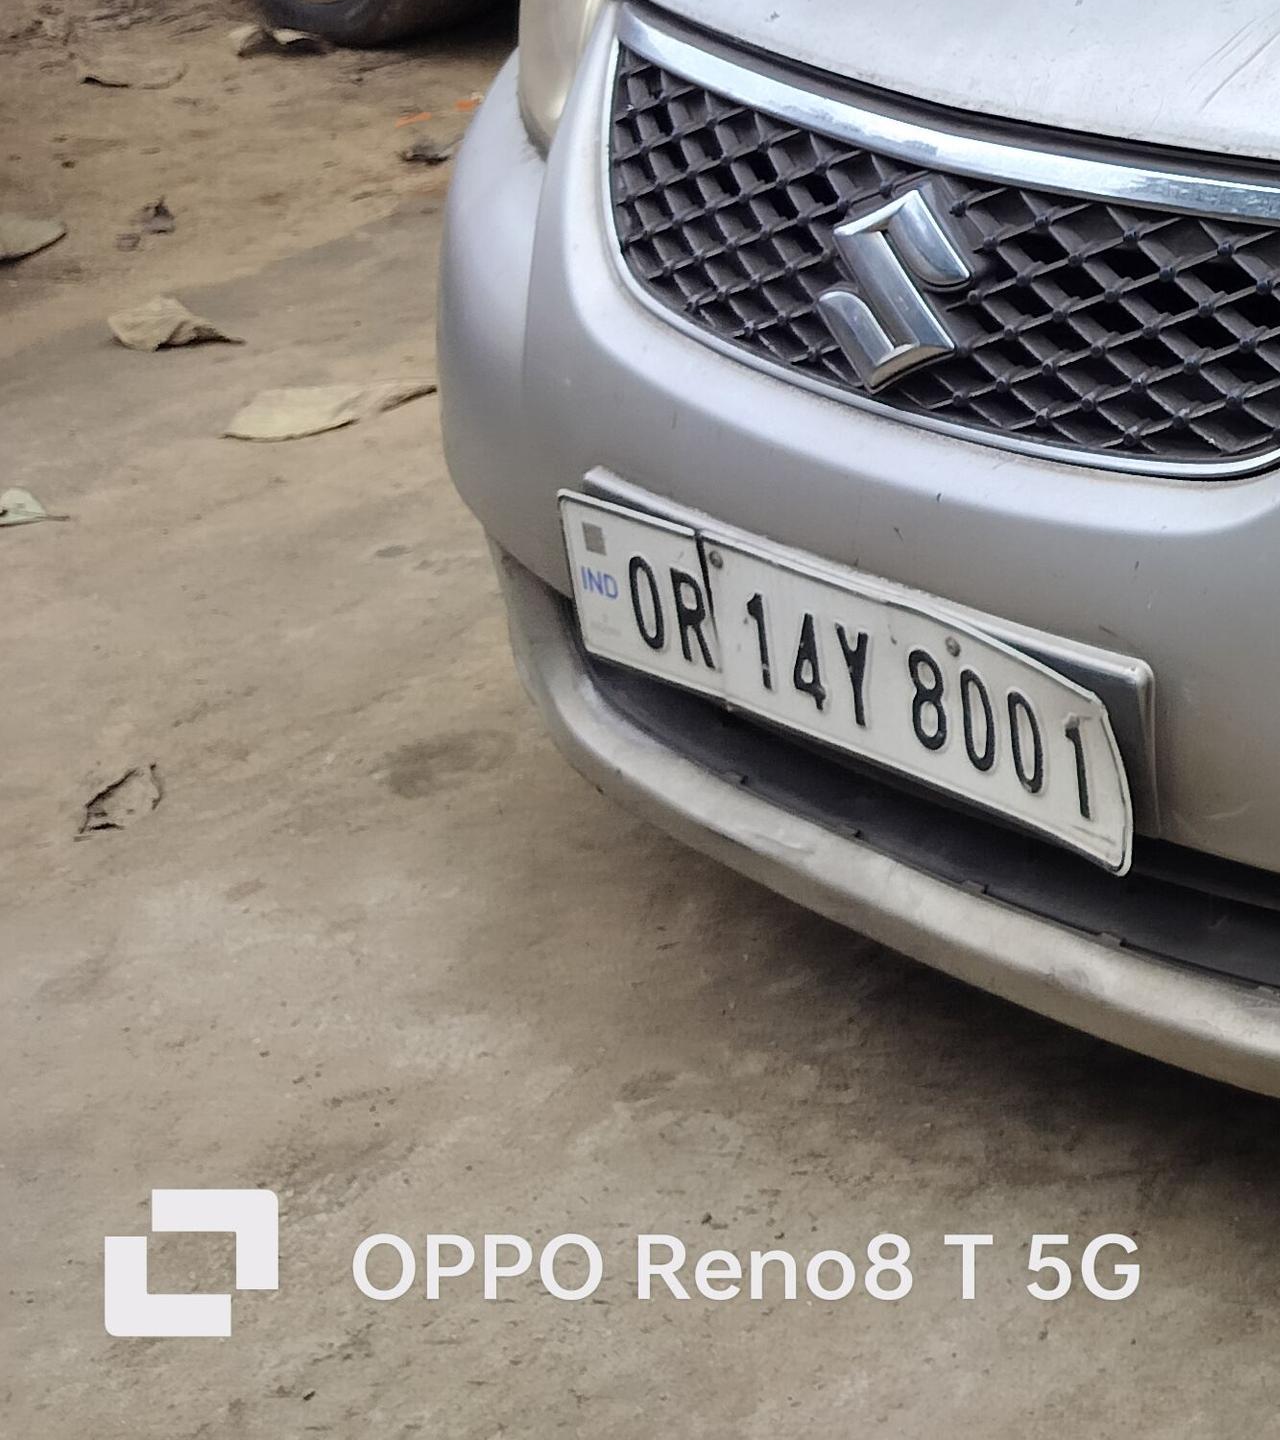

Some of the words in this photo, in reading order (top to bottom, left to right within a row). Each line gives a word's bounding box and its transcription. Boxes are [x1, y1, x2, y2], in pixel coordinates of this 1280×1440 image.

[581, 566, 618, 600] IND
[629, 556, 715, 669] OR
[908, 649, 1090, 819] 8001
